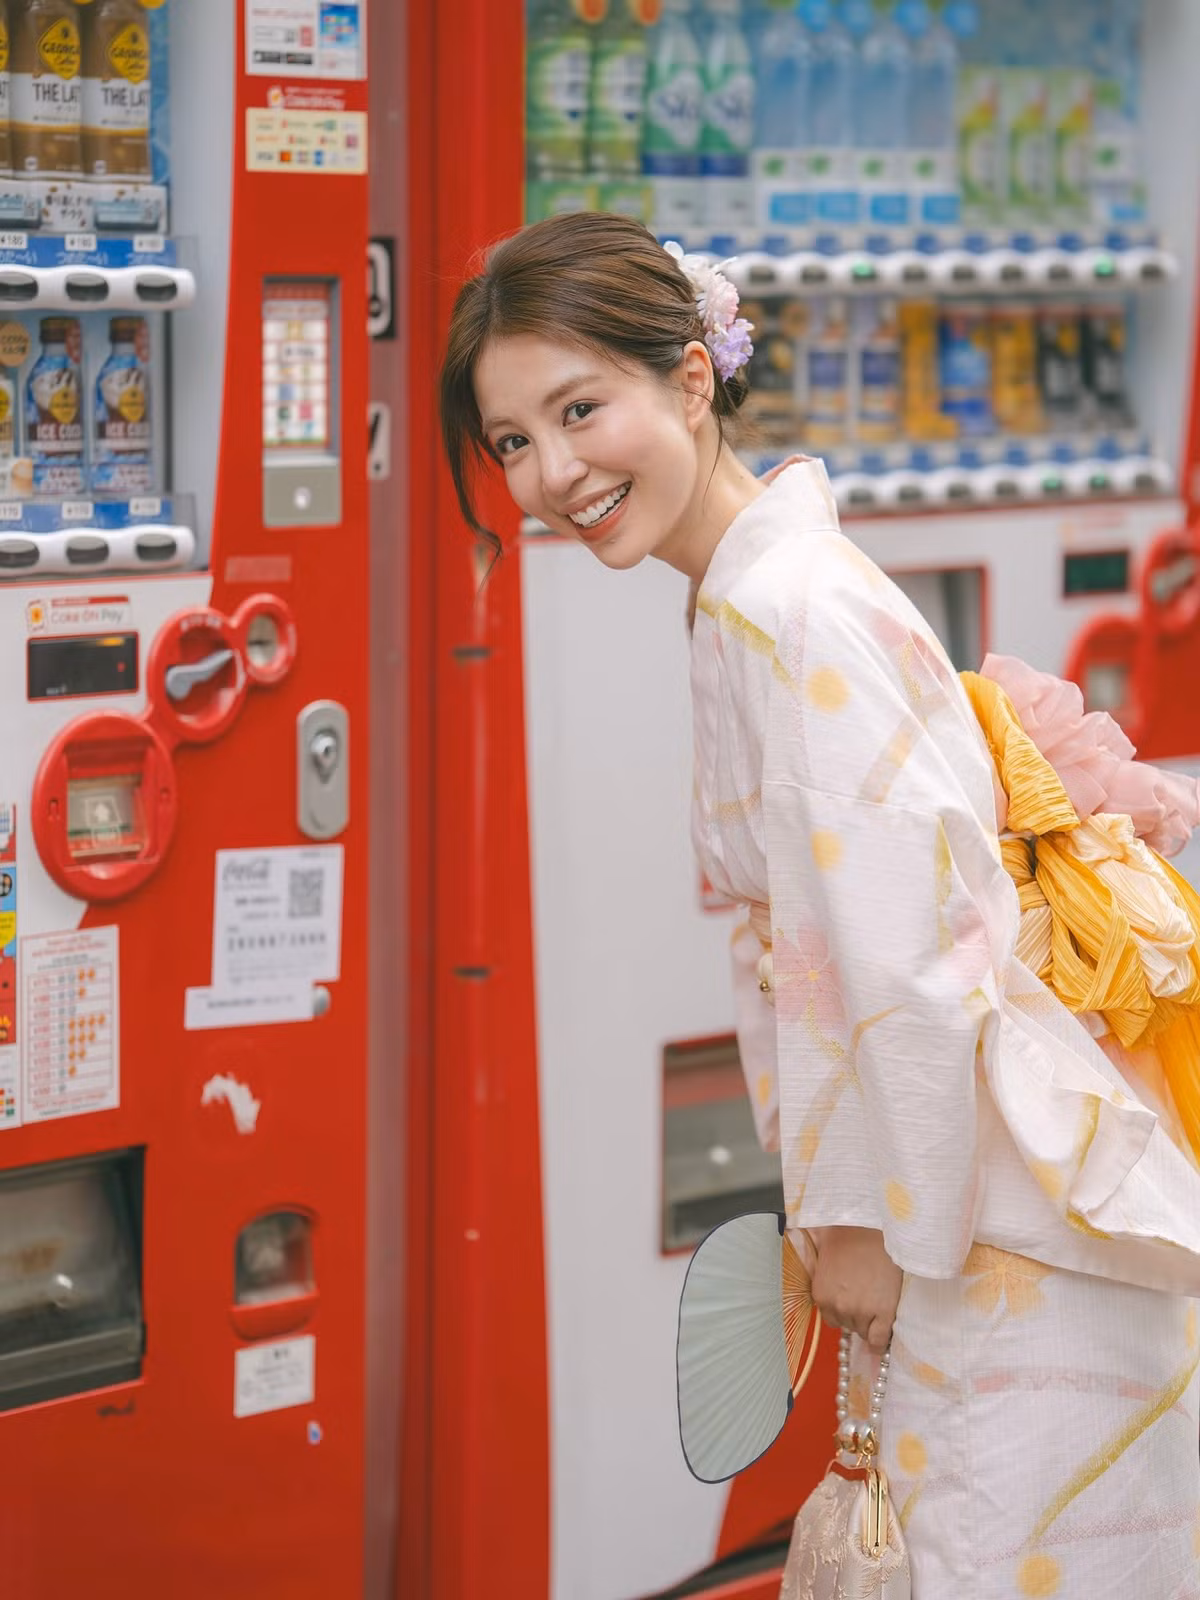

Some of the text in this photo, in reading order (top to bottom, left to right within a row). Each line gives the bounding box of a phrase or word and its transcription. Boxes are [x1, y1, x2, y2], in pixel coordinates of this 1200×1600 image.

[32, 82, 60, 102] THE
[102, 86, 128, 107] THE
[101, 607, 124, 623] Pay
